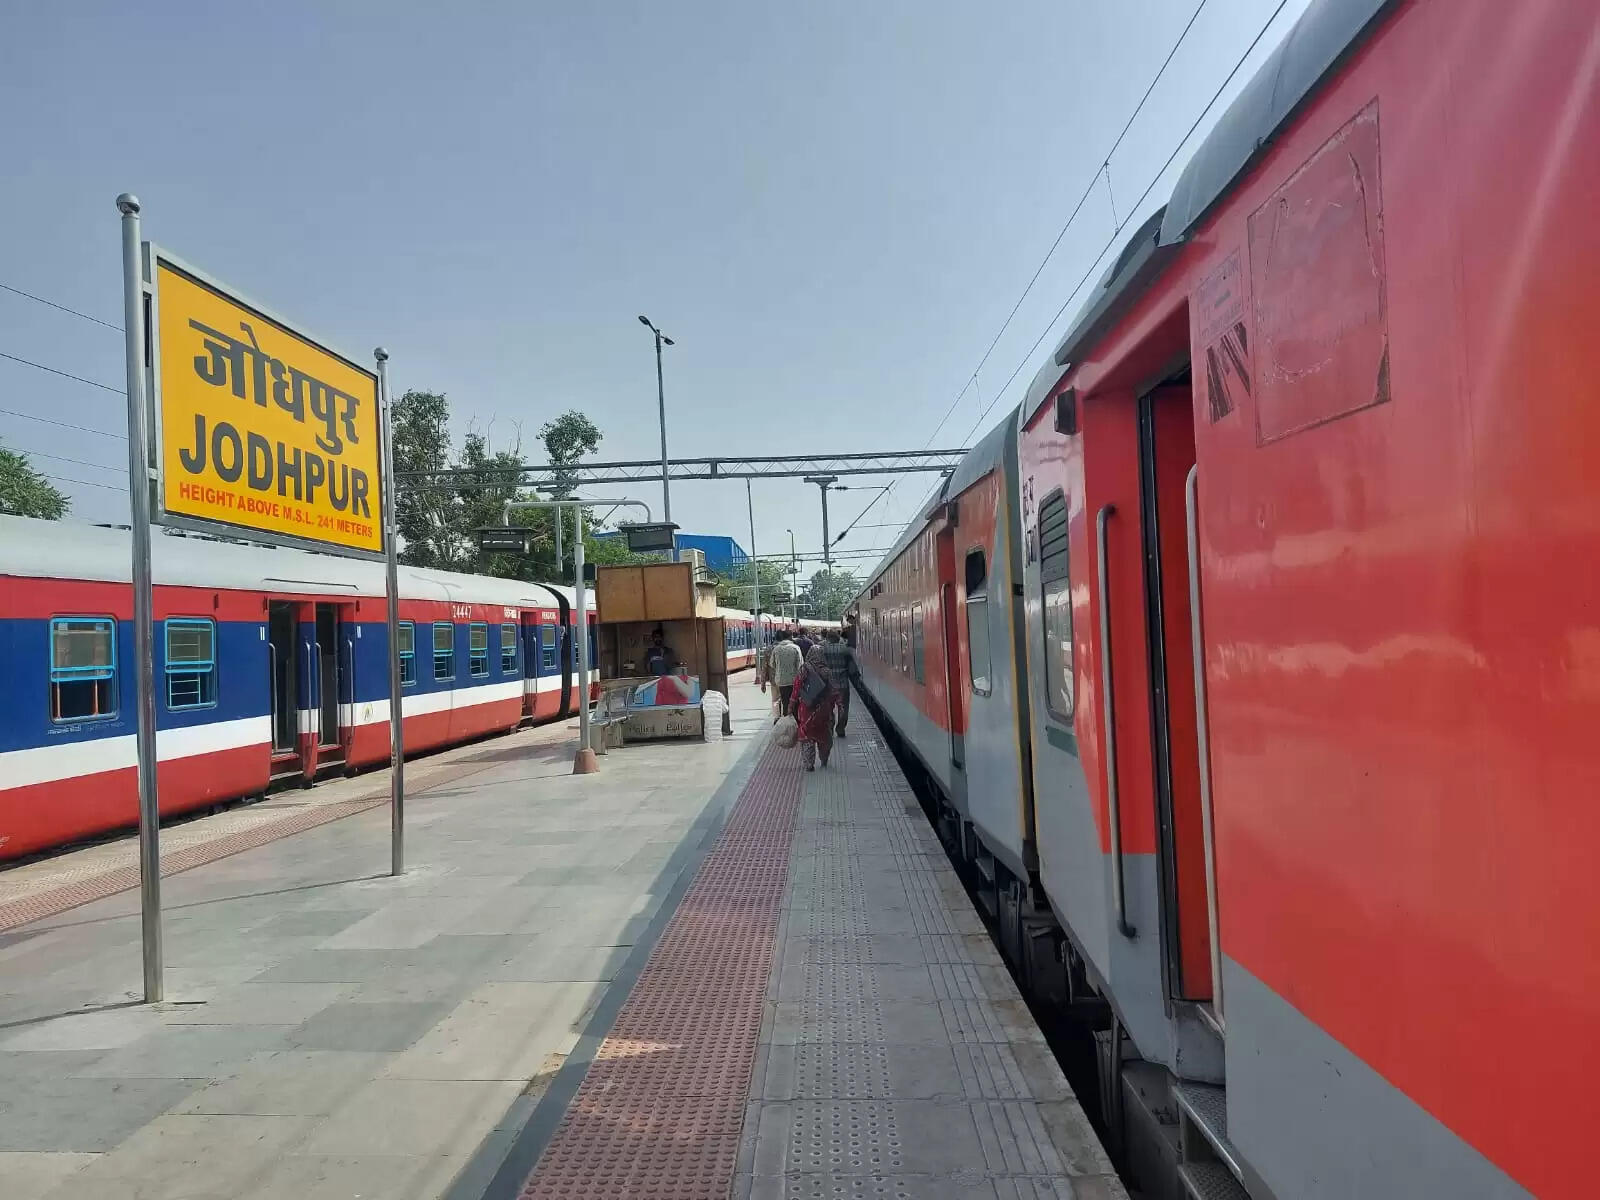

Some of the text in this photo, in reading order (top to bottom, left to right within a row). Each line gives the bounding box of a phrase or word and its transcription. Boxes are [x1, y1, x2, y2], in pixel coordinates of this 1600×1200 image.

[189, 319, 360, 455] जोधपुर
[179, 413, 371, 518] JODHPUR
[179, 482, 373, 539] HEIGHT ABOVE M.S.L. 241 METERS
